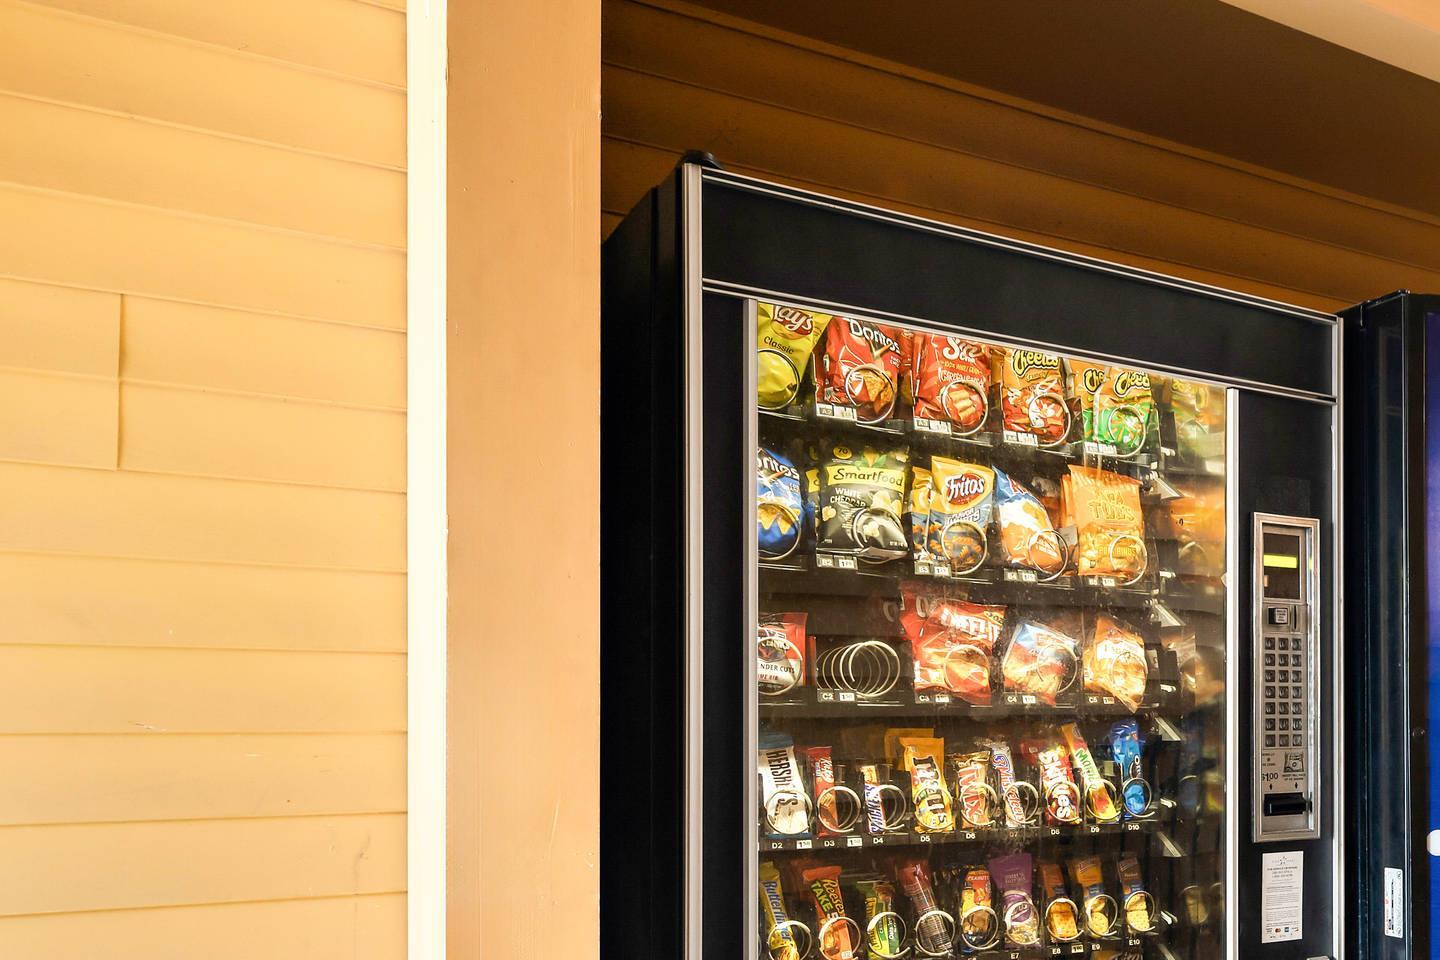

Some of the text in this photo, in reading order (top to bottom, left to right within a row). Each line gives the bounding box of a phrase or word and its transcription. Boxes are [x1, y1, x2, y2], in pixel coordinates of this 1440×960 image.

[773, 304, 814, 331] Lay's
[763, 336, 795, 355] Classic
[850, 319, 901, 354] Doritos
[833, 468, 904, 487] Smartfood
[946, 473, 985, 501] Fritos
[764, 880, 792, 942] Butterfiner
[811, 880, 835, 914] TAKE
